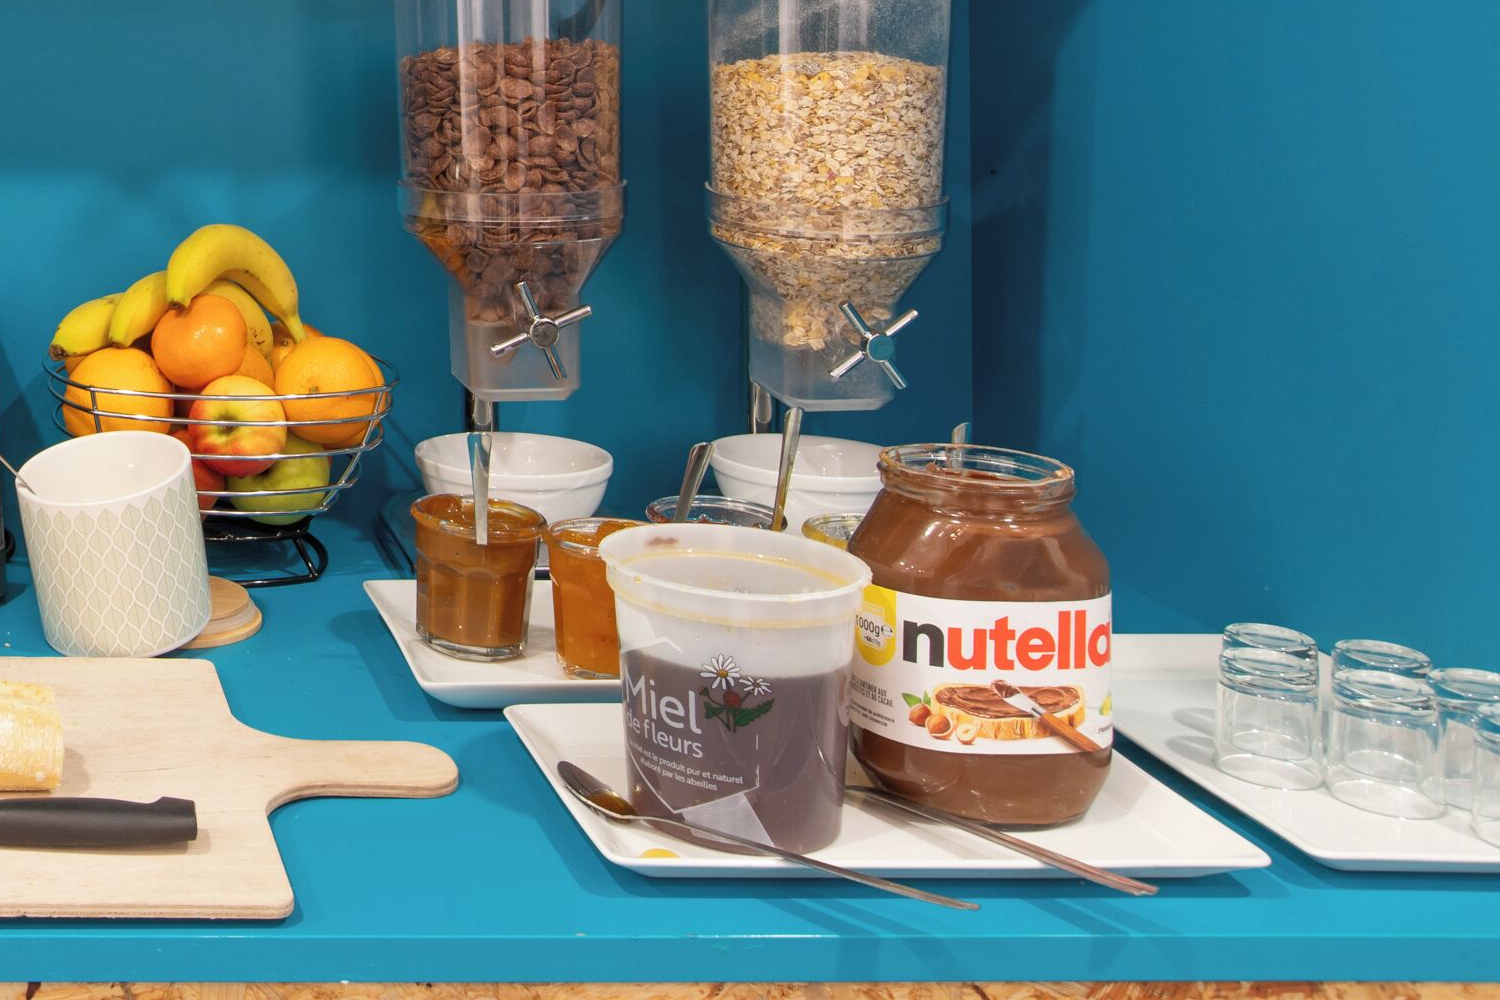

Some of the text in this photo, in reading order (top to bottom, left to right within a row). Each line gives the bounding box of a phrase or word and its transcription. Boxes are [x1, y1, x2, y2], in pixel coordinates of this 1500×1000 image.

[902, 609, 1111, 671] nutella
[624, 663, 702, 734] Miel
[627, 708, 641, 734] de
[643, 719, 703, 758] fleurs
[660, 757, 685, 772] produit
[686, 766, 700, 776] pur
[702, 770, 711, 779] et
[712, 773, 743, 784] naturel
[662, 769, 674, 779] par
[675, 772, 686, 783] les
[686, 776, 718, 791] abeilles
